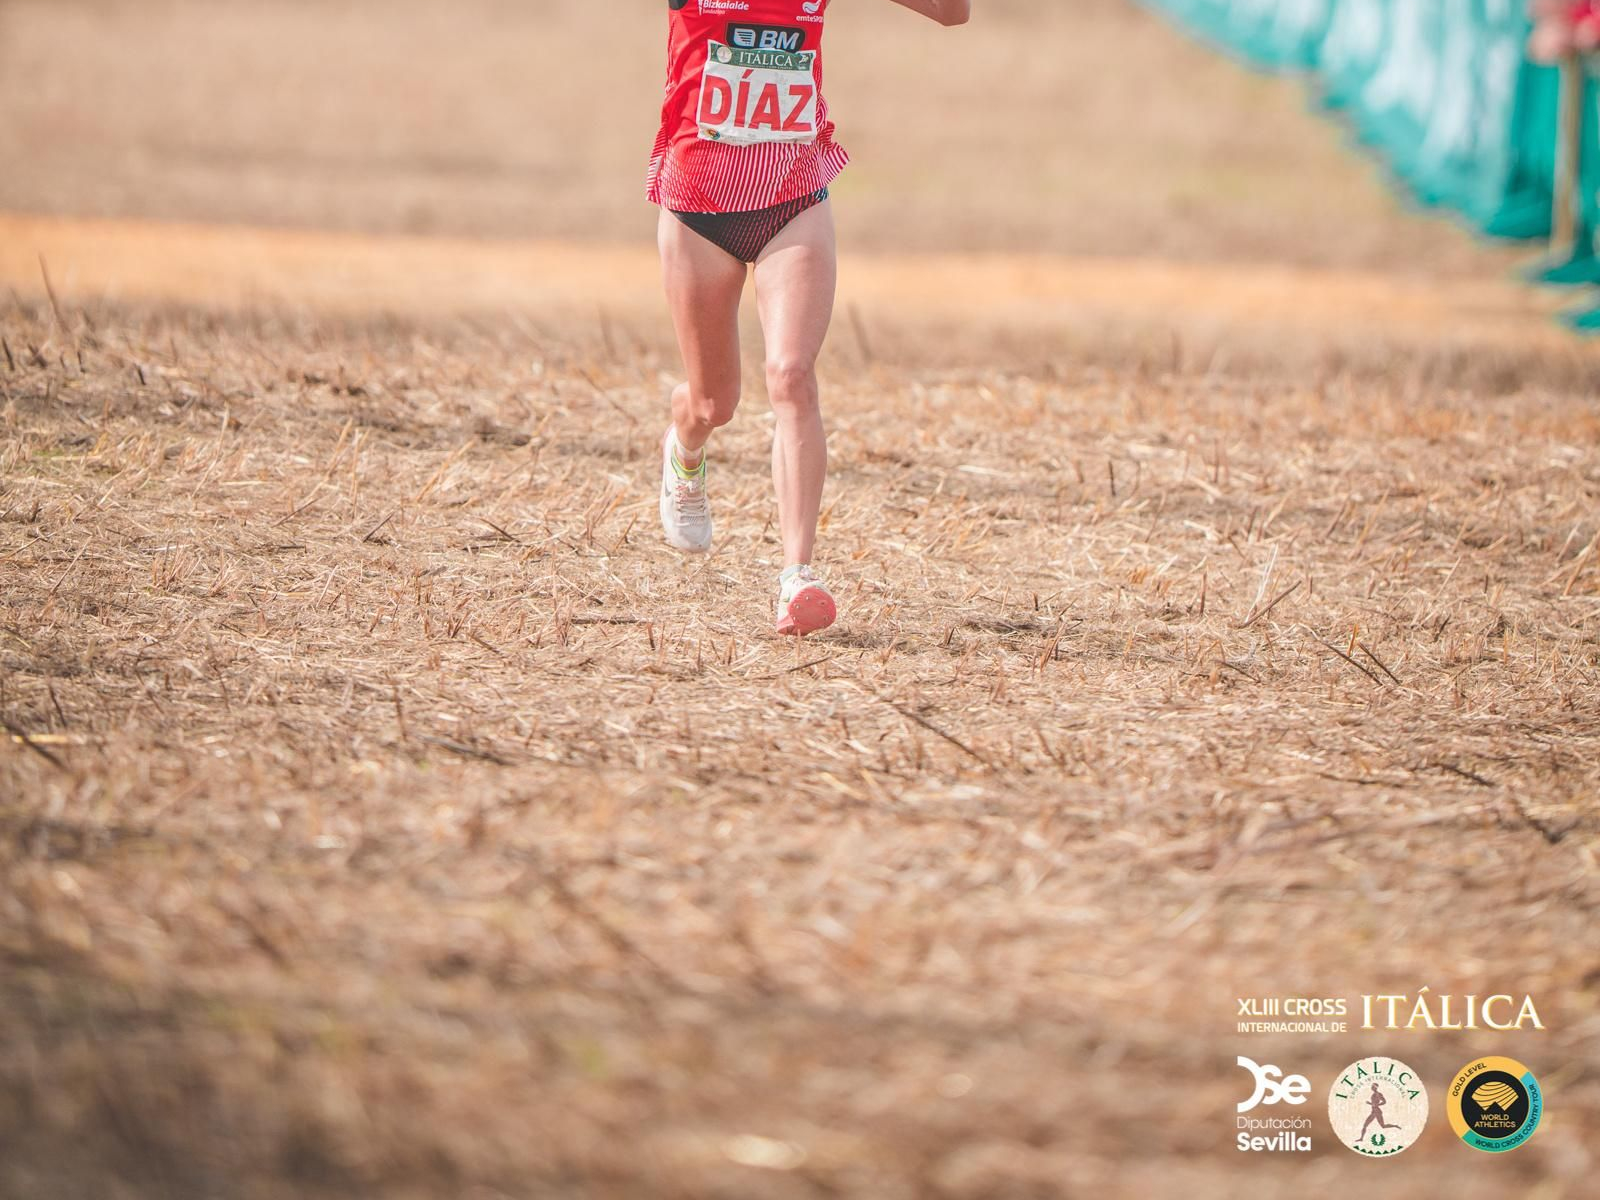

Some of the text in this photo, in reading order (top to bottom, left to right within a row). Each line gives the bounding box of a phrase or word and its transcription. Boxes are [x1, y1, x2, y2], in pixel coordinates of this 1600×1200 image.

[759, 30, 799, 50] BM
[739, 50, 793, 67] ITÁLICA
[701, 69, 813, 132] DÍAZ
